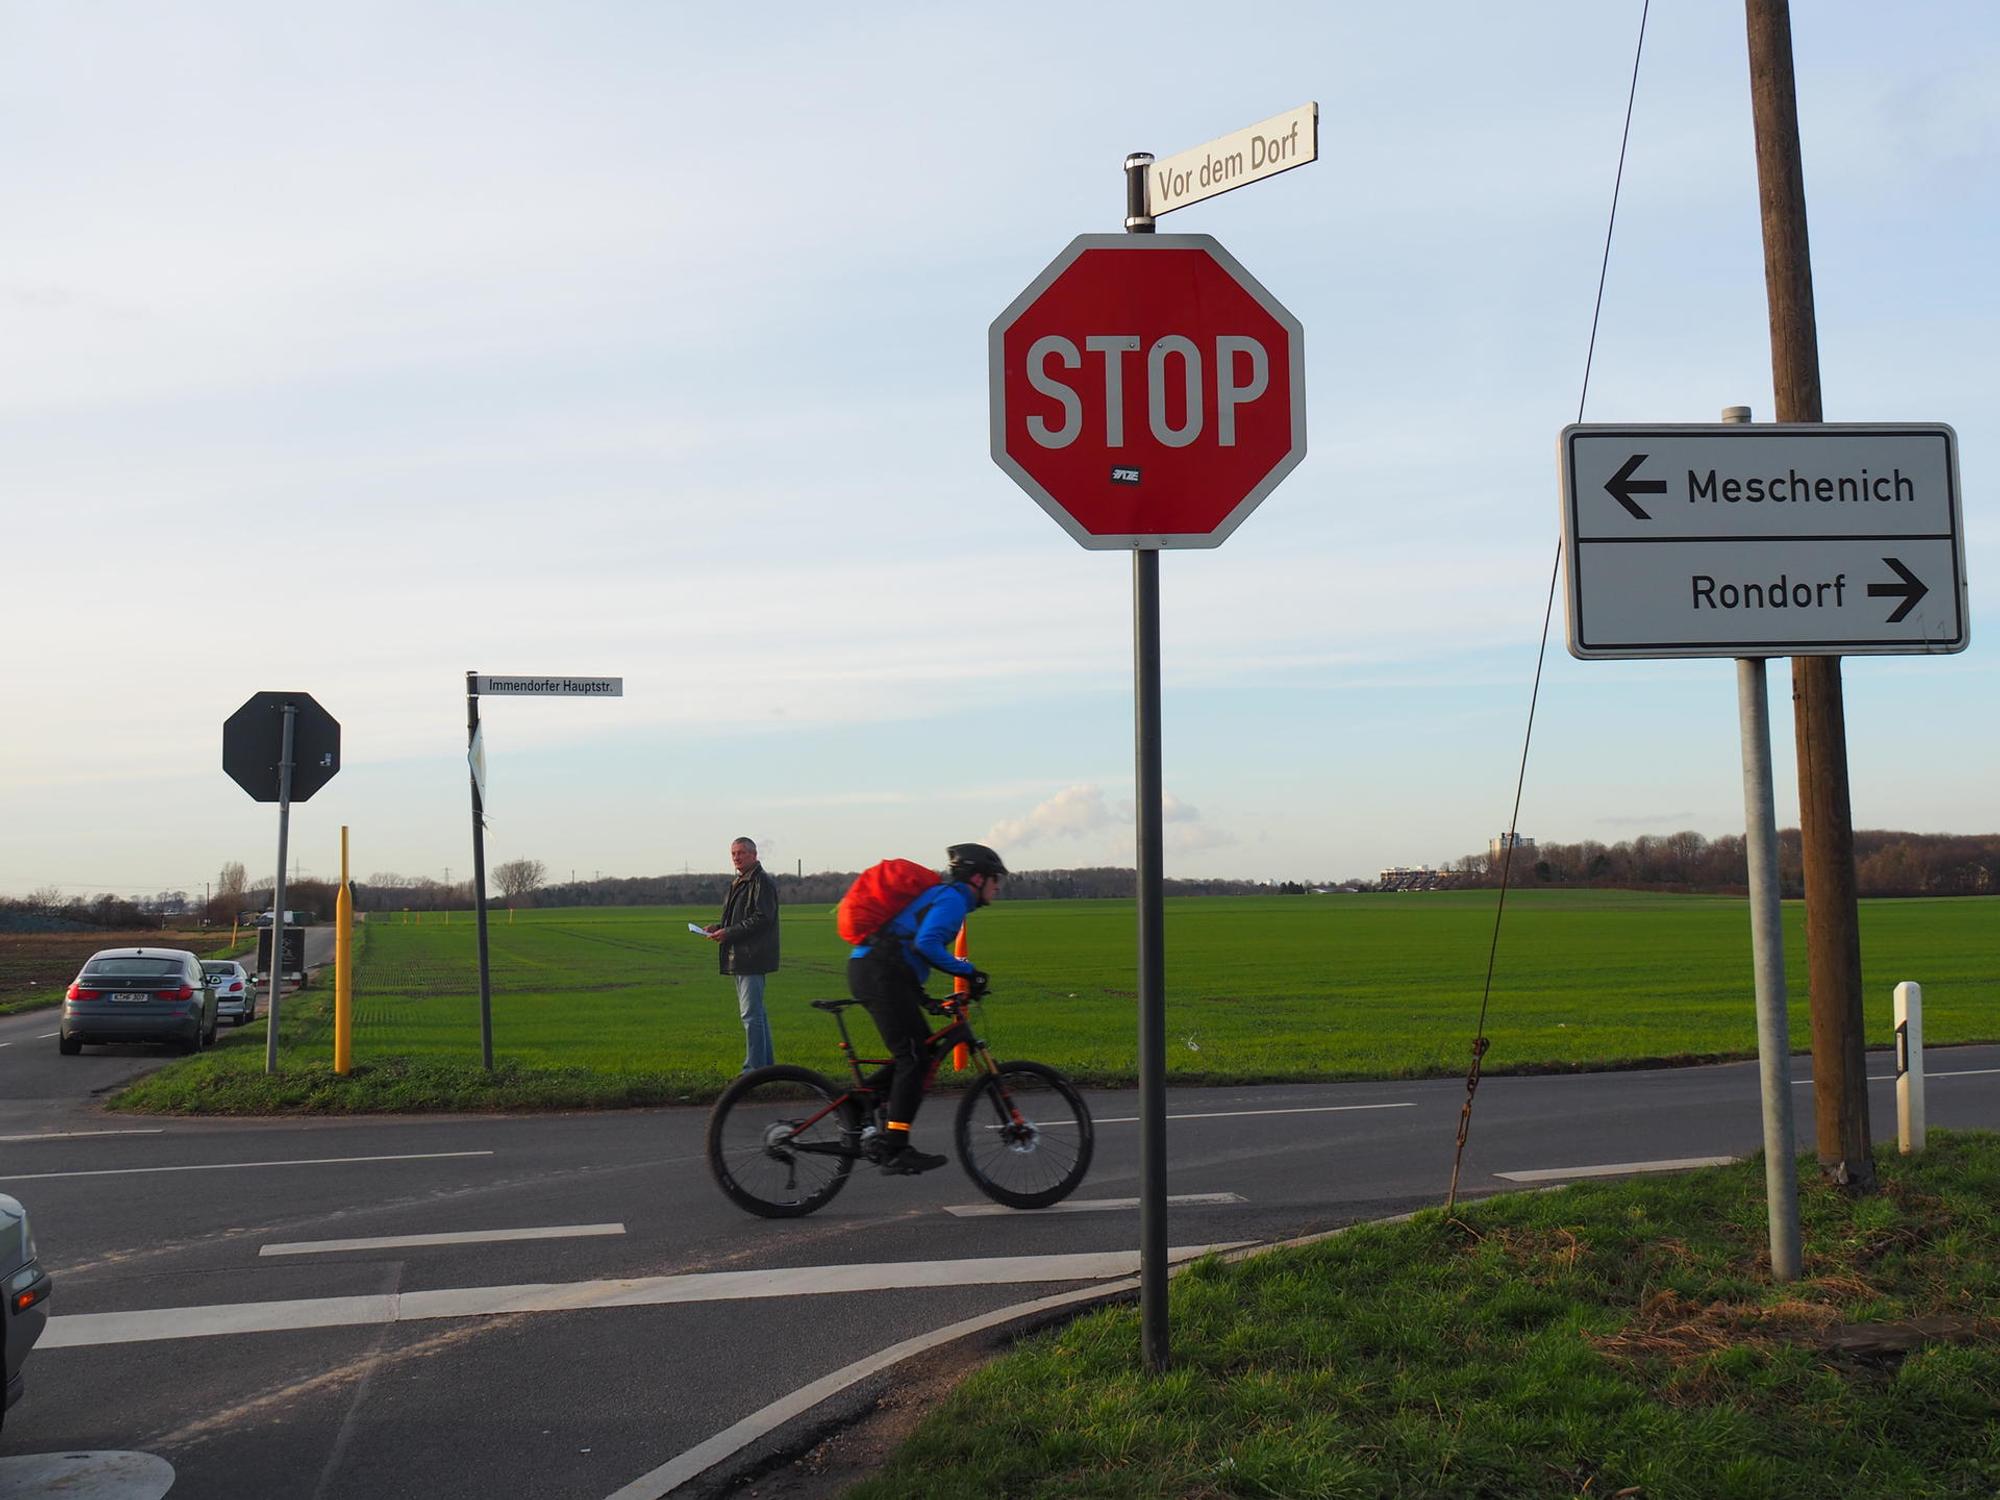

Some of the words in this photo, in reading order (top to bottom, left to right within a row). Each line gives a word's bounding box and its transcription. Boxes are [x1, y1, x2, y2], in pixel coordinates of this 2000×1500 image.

[1159, 168, 1192, 201] Vor
[1200, 154, 1242, 188] dem
[1252, 121, 1298, 170] Dorf
[1025, 334, 1270, 449] STOP
[1688, 469, 1914, 503] Meschenich
[1692, 574, 1846, 609] Rondorf
[489, 678, 560, 692] Immendorfer
[563, 680, 613, 694] Hauptstr.
